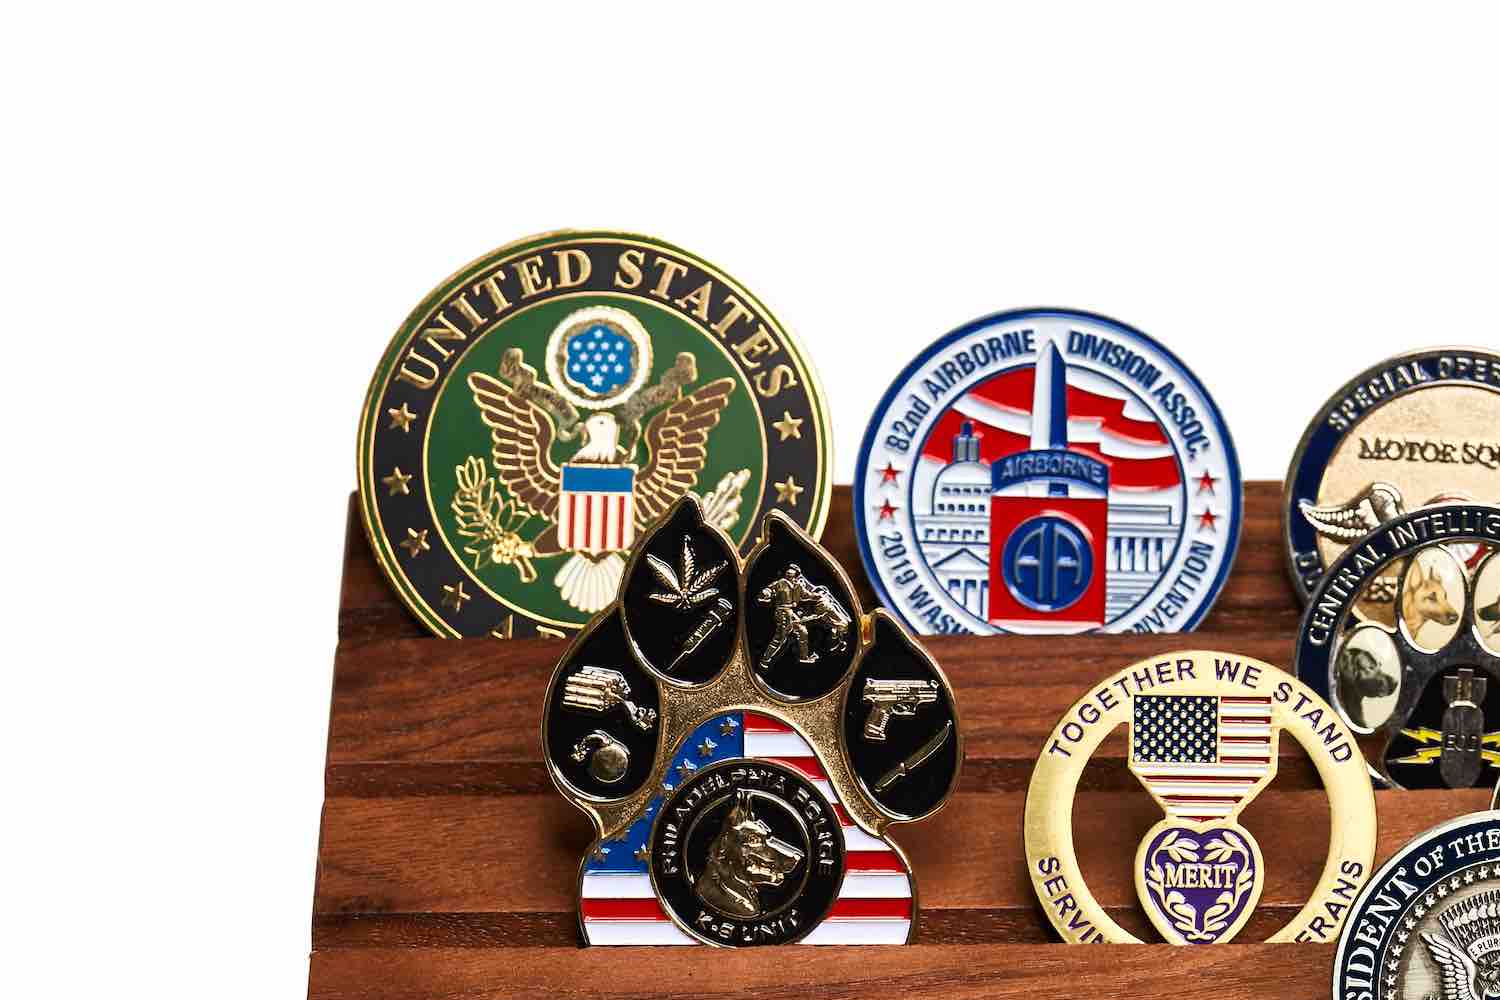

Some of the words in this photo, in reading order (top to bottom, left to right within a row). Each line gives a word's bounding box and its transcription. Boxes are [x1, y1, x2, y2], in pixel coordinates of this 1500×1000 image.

[400, 248, 592, 390] UNITED
[614, 249, 798, 398] STATES
[887, 397, 930, 452] 82nd
[924, 329, 1036, 403] AIRBORNE
[1066, 329, 1161, 393] DIVISION
[1152, 377, 1211, 462] ASSOC.
[1328, 360, 1427, 433] SPECIAL
[1000, 456, 1105, 484] AIRBORNE
[1358, 438, 1457, 463] MOTOR
[879, 531, 919, 588] 2019
[1308, 541, 1388, 647] CENTRAL
[1049, 658, 1197, 760] TOGETHER
[1215, 659, 1262, 689] WE
[1273, 682, 1353, 764] STAND
[1164, 863, 1238, 889] MERIT
[1414, 848, 1446, 878] OF
